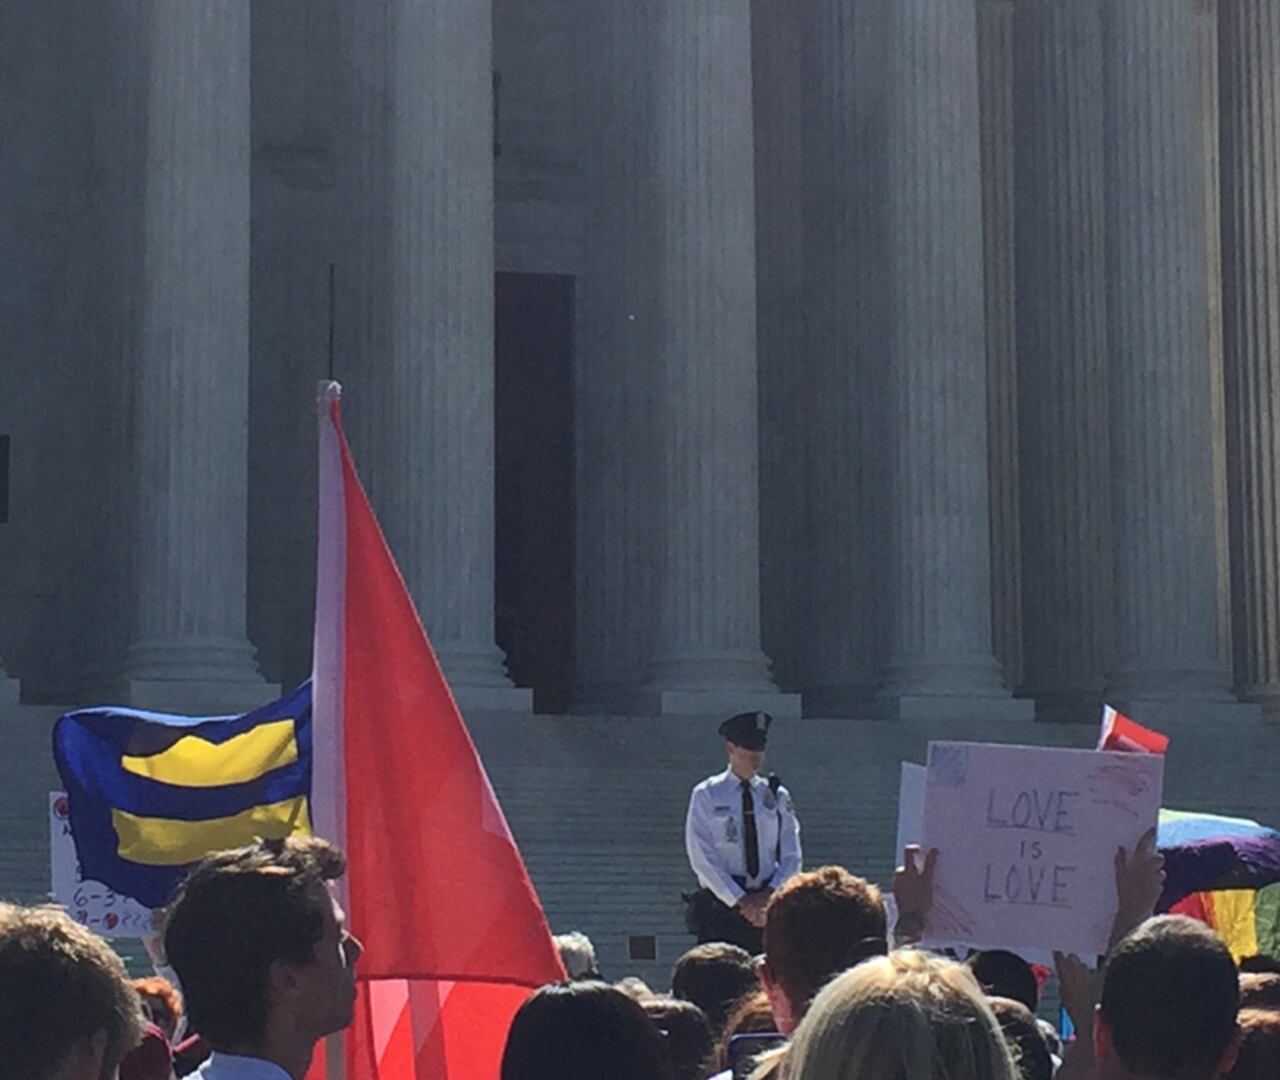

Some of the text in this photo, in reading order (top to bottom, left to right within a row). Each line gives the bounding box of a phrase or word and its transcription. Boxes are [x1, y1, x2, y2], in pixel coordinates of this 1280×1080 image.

[986, 788, 1079, 831] LOVE
[1020, 841, 1042, 860] IS
[984, 863, 1076, 902] LOVE
